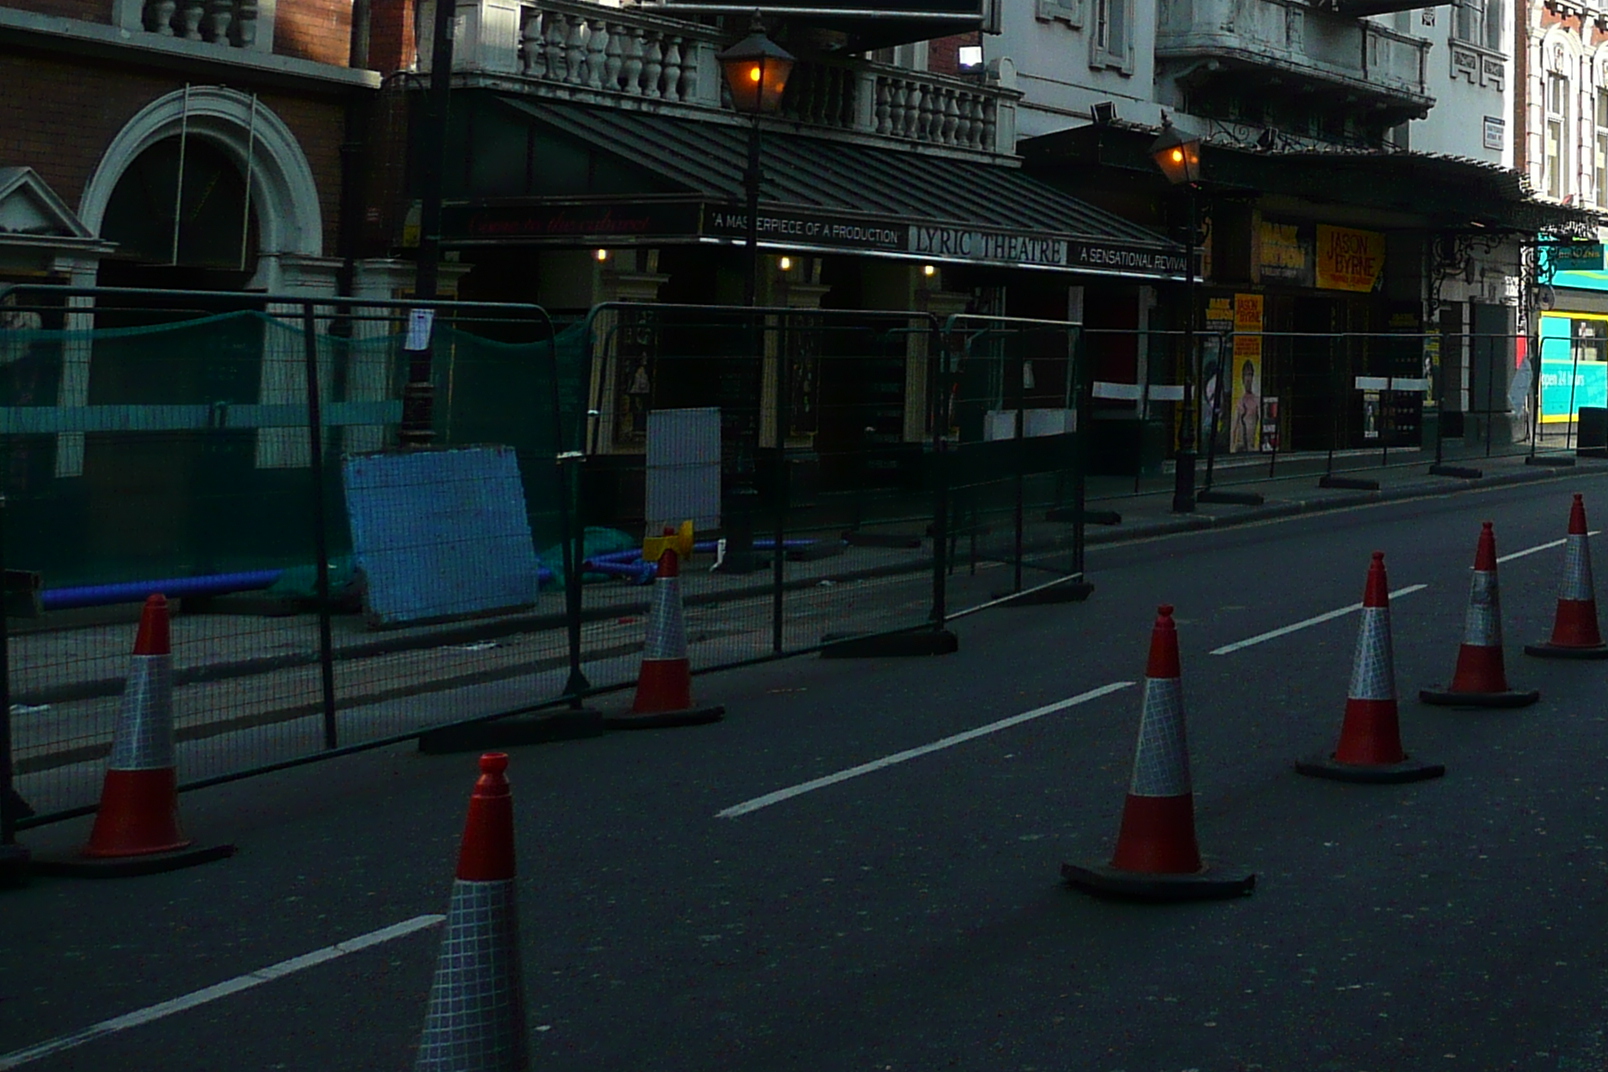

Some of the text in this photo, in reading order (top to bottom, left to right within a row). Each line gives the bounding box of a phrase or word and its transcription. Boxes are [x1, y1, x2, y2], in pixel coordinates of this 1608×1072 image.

[726, 213, 804, 236] MASERPIECE
[805, 222, 821, 237] OF
[822, 224, 831, 237] A
[915, 225, 1063, 266] LYRIC THEATRE
[1326, 230, 1369, 260] JASON
[1089, 249, 1152, 269] SENSATIONAL
[1334, 253, 1376, 277] BYRNE
